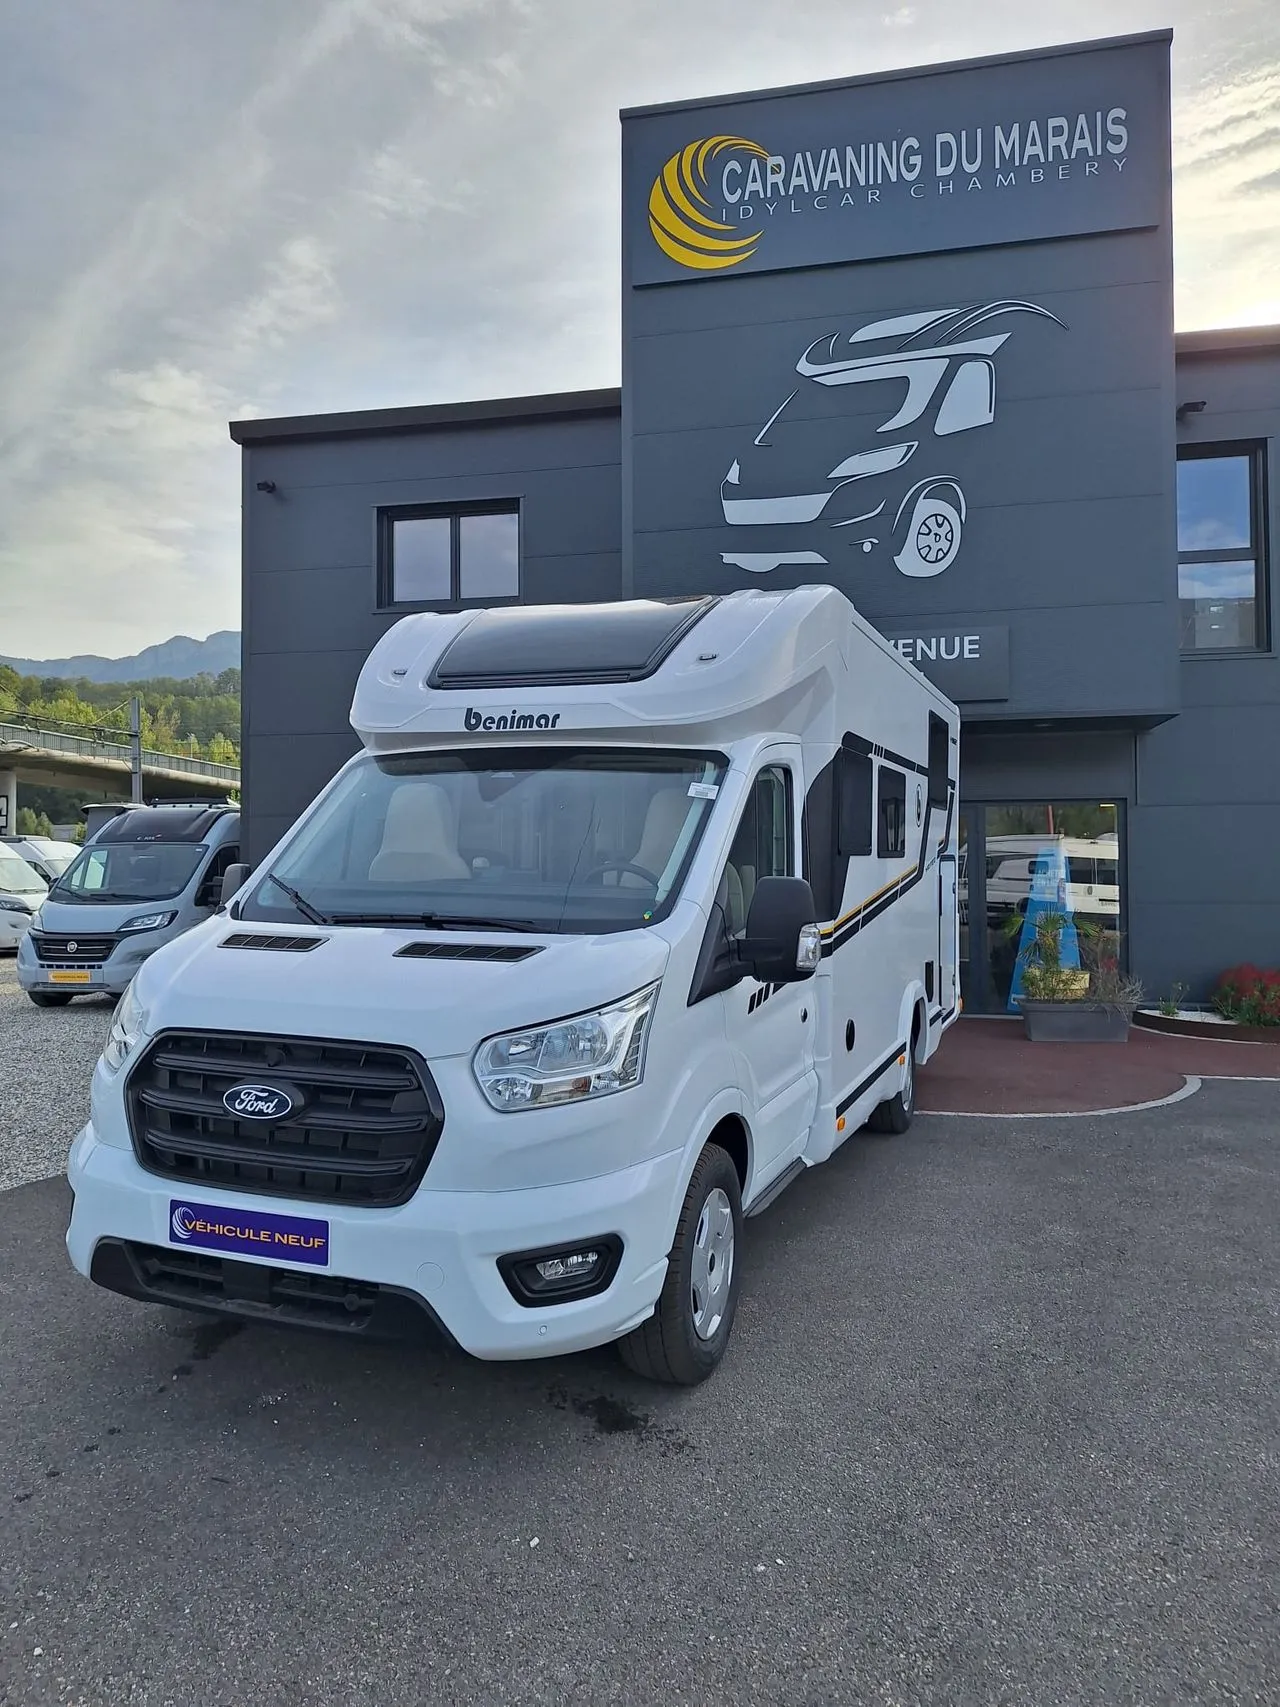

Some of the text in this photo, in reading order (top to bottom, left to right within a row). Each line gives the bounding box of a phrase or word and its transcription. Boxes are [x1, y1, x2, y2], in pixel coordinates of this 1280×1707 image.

[721, 108, 1128, 203] CARAVANING DU MARAIS
[721, 158, 1128, 221] IDYLCAR CHAMBERY
[464, 707, 561, 731] benimar
[235, 1089, 279, 1113] Ford
[184, 1219, 326, 1249] VÉHICULE NEUF
